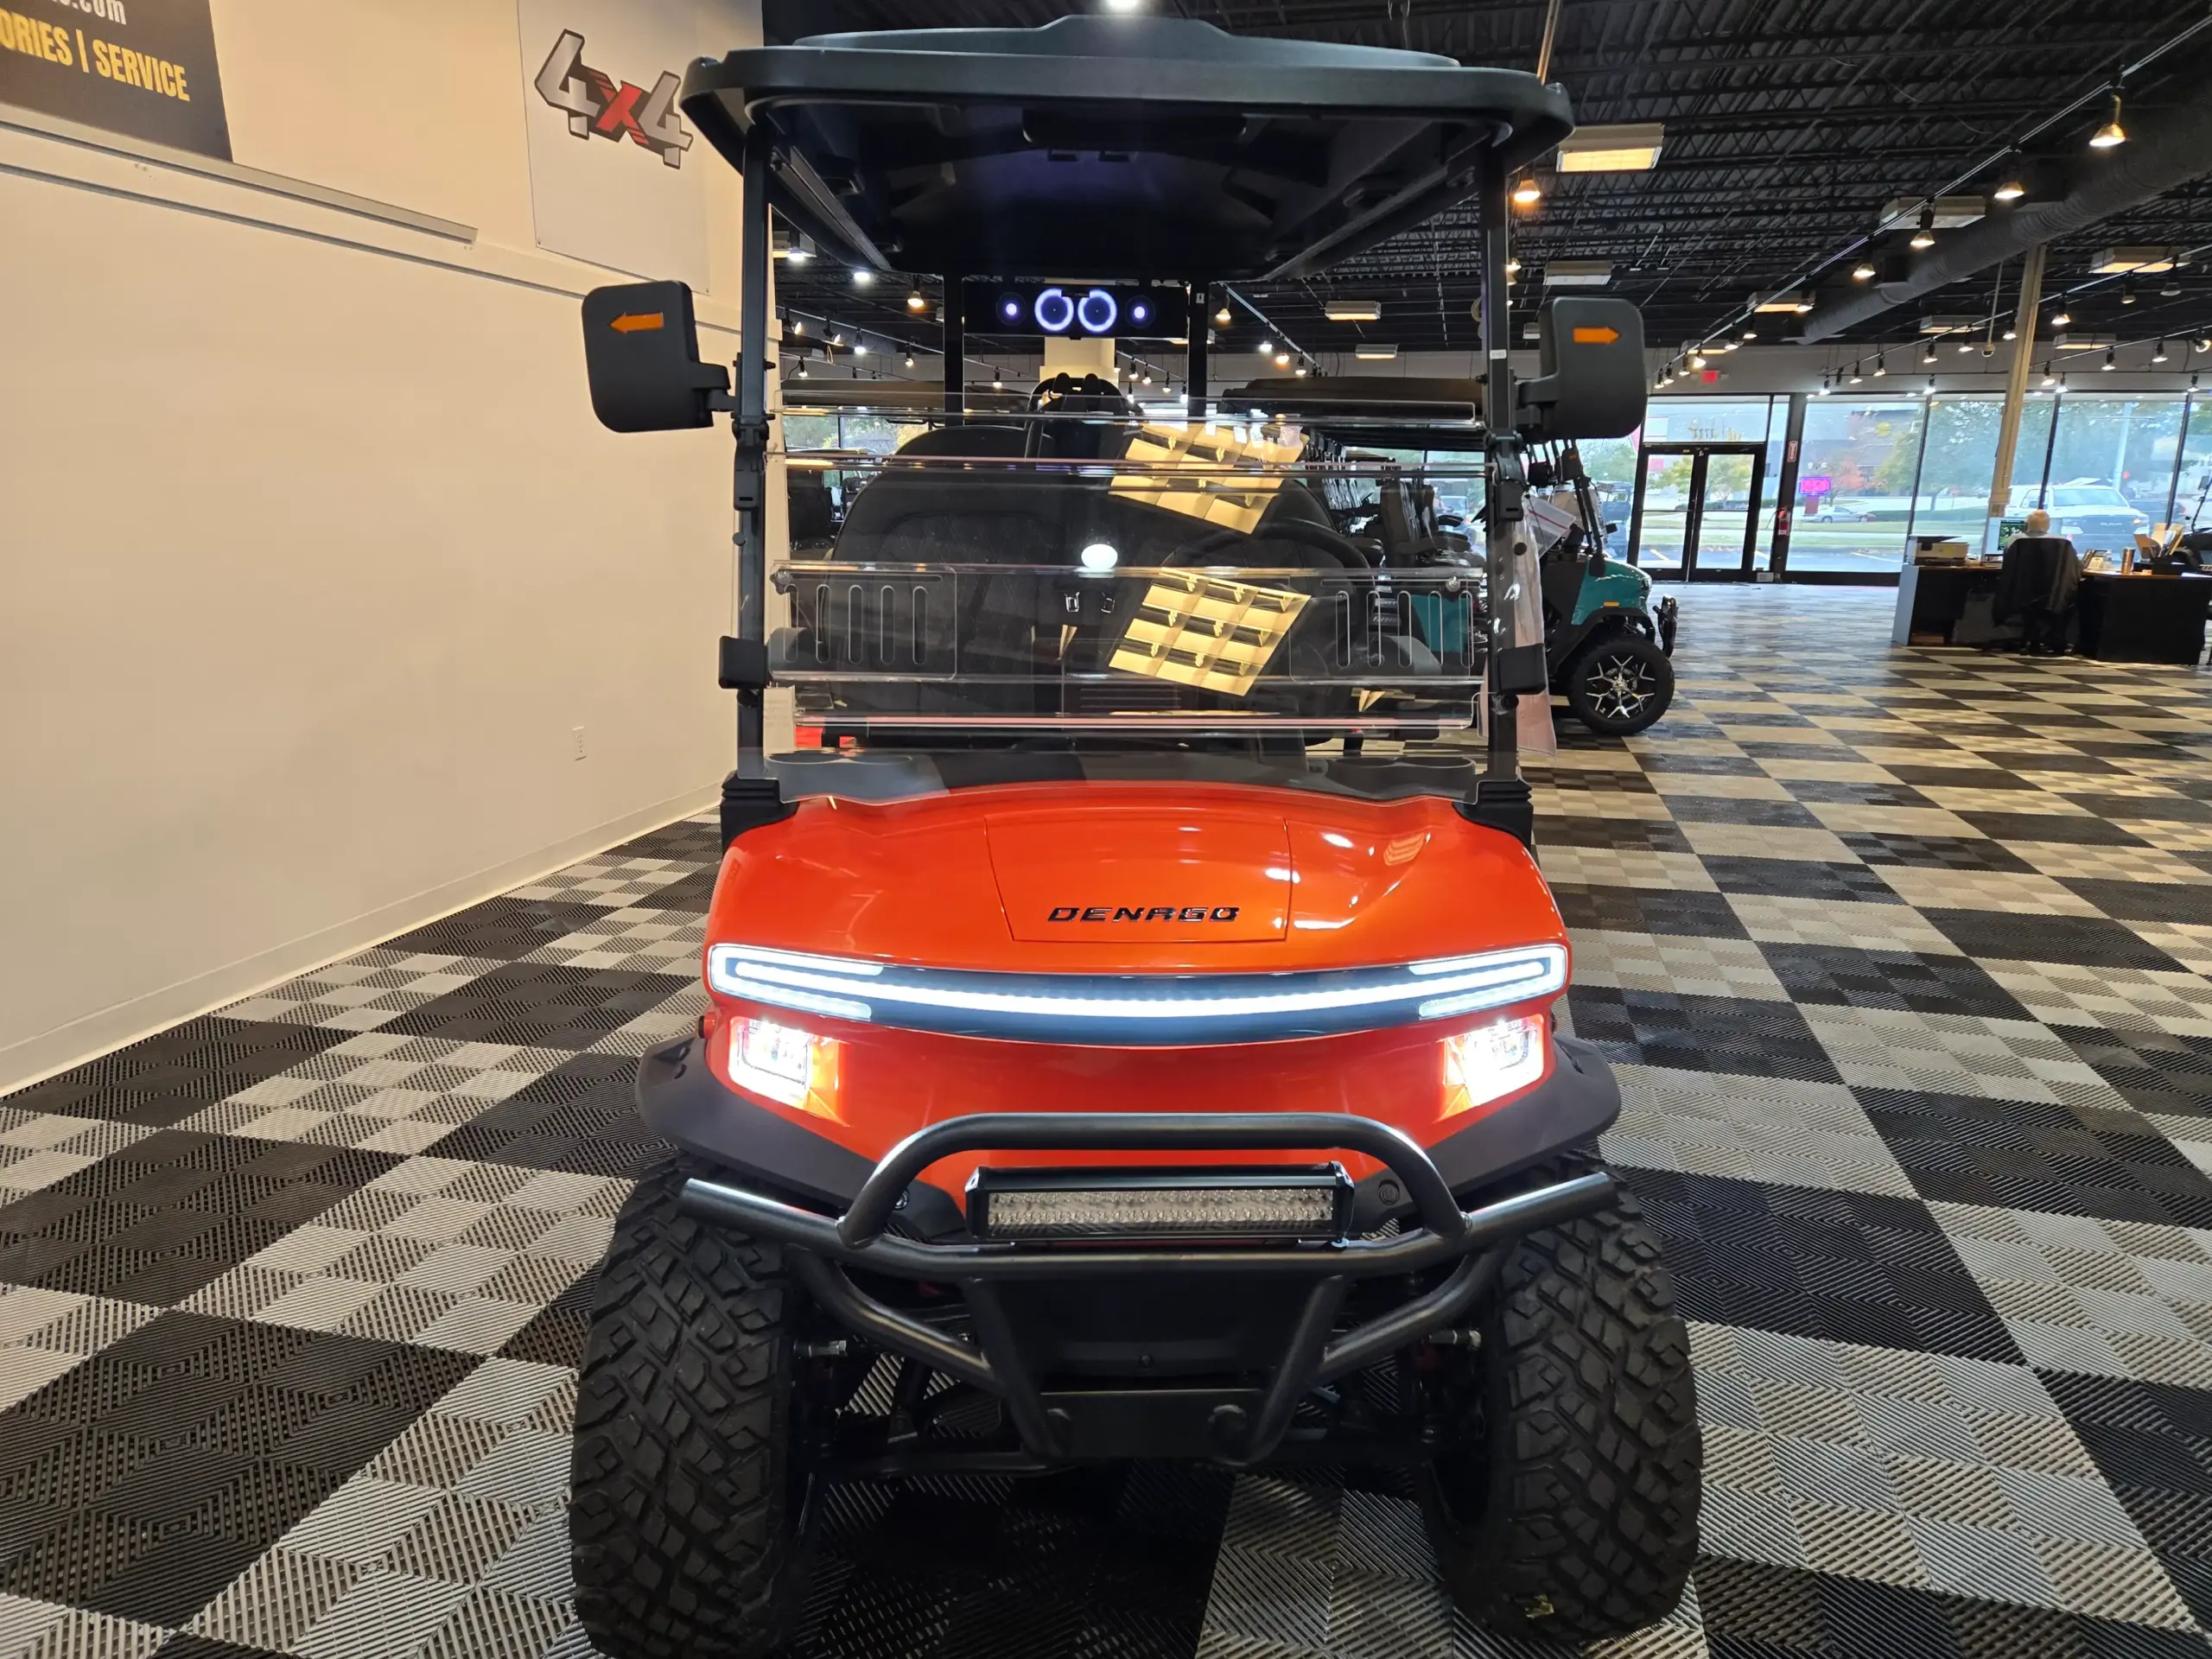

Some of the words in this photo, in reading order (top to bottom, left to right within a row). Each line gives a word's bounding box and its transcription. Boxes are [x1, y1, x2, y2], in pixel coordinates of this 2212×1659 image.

[0, 8, 73, 66] ORIES
[92, 39, 190, 102] SERVICE
[1047, 906, 1240, 923] DENAGO
